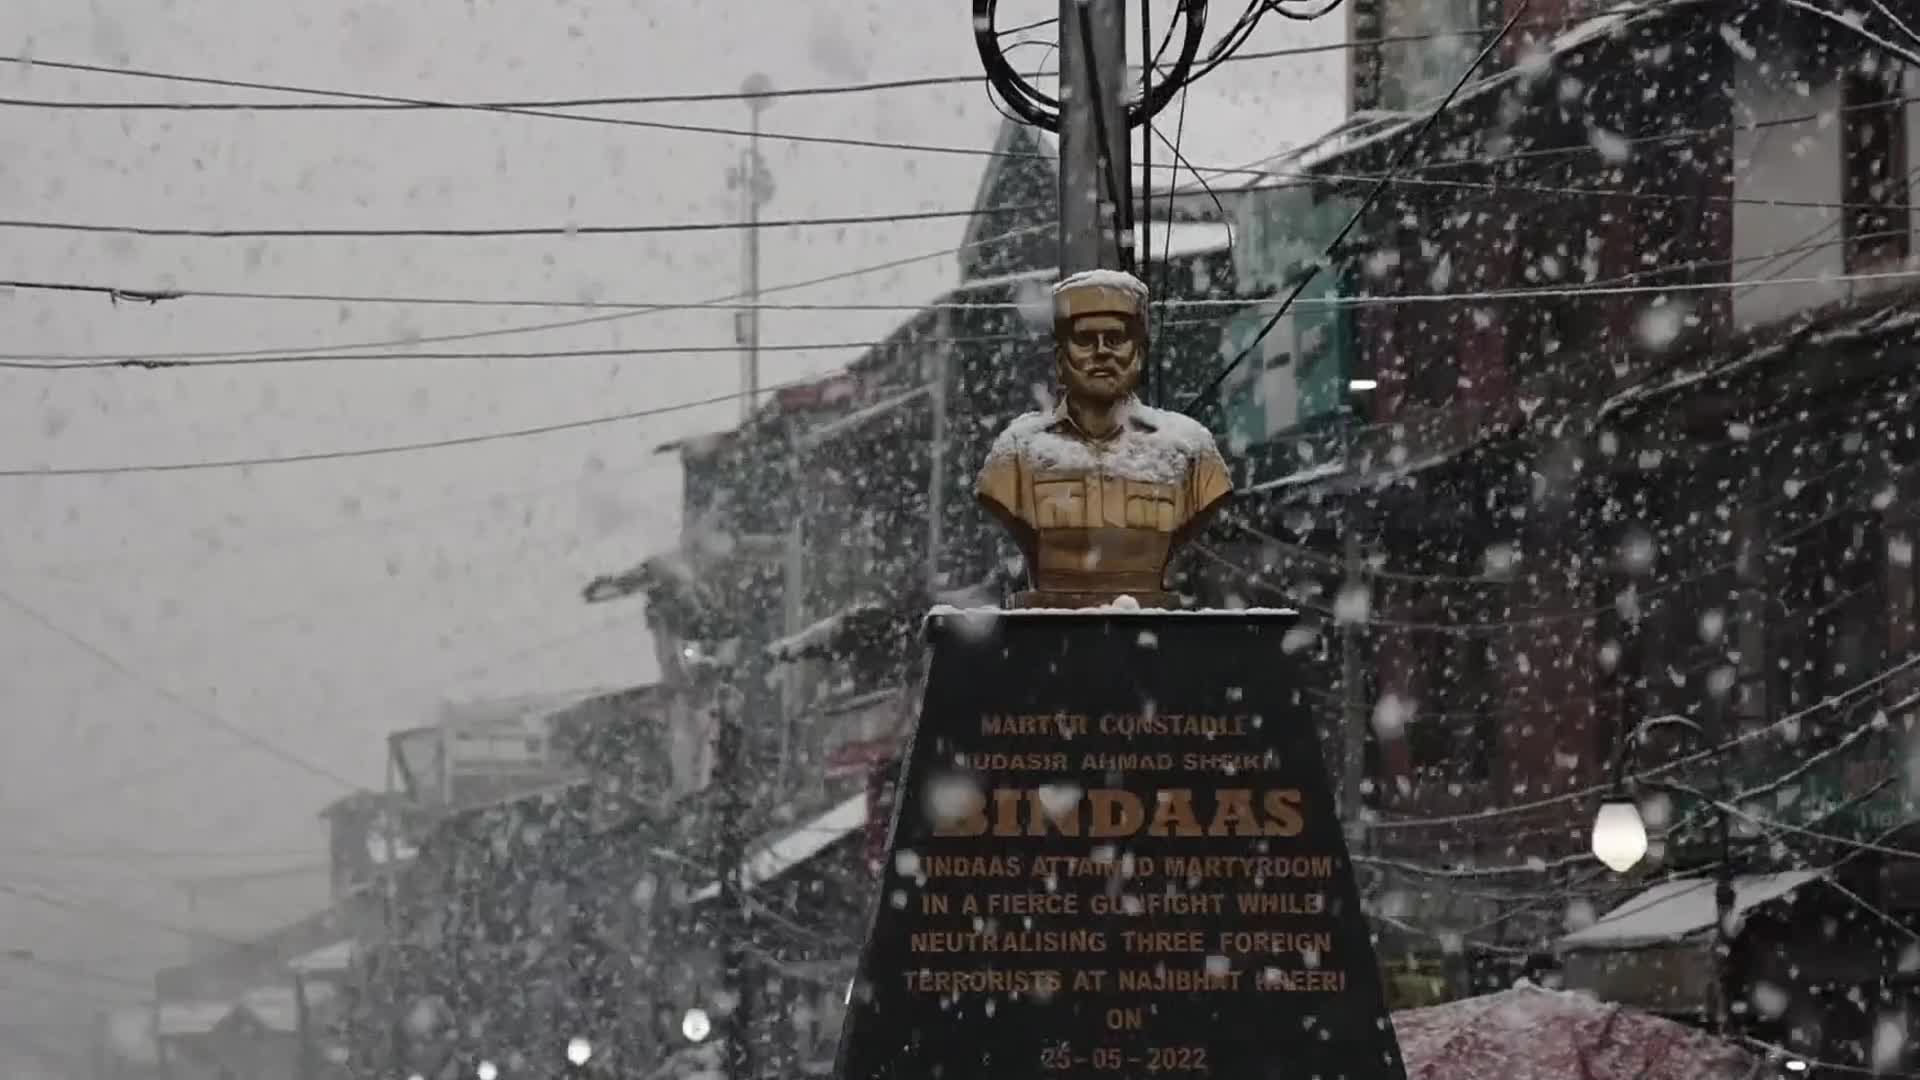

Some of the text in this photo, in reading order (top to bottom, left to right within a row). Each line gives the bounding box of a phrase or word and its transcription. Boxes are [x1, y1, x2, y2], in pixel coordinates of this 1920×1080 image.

[1080, 751, 1174, 771] AHMAD
[911, 855, 1332, 878] INDAAS ATTAIND MARTYRDOM
[920, 893, 949, 915] IN
[961, 893, 979, 915] A
[987, 893, 1078, 915] FIERCE
[1237, 893, 1324, 915] WHILE
[910, 931, 1332, 953] NEUTRALISING THREE FOREIGN
[902, 969, 1064, 993] TERRORISTS
[1072, 970, 1107, 993] AT
[1106, 1007, 1143, 1031] ON
